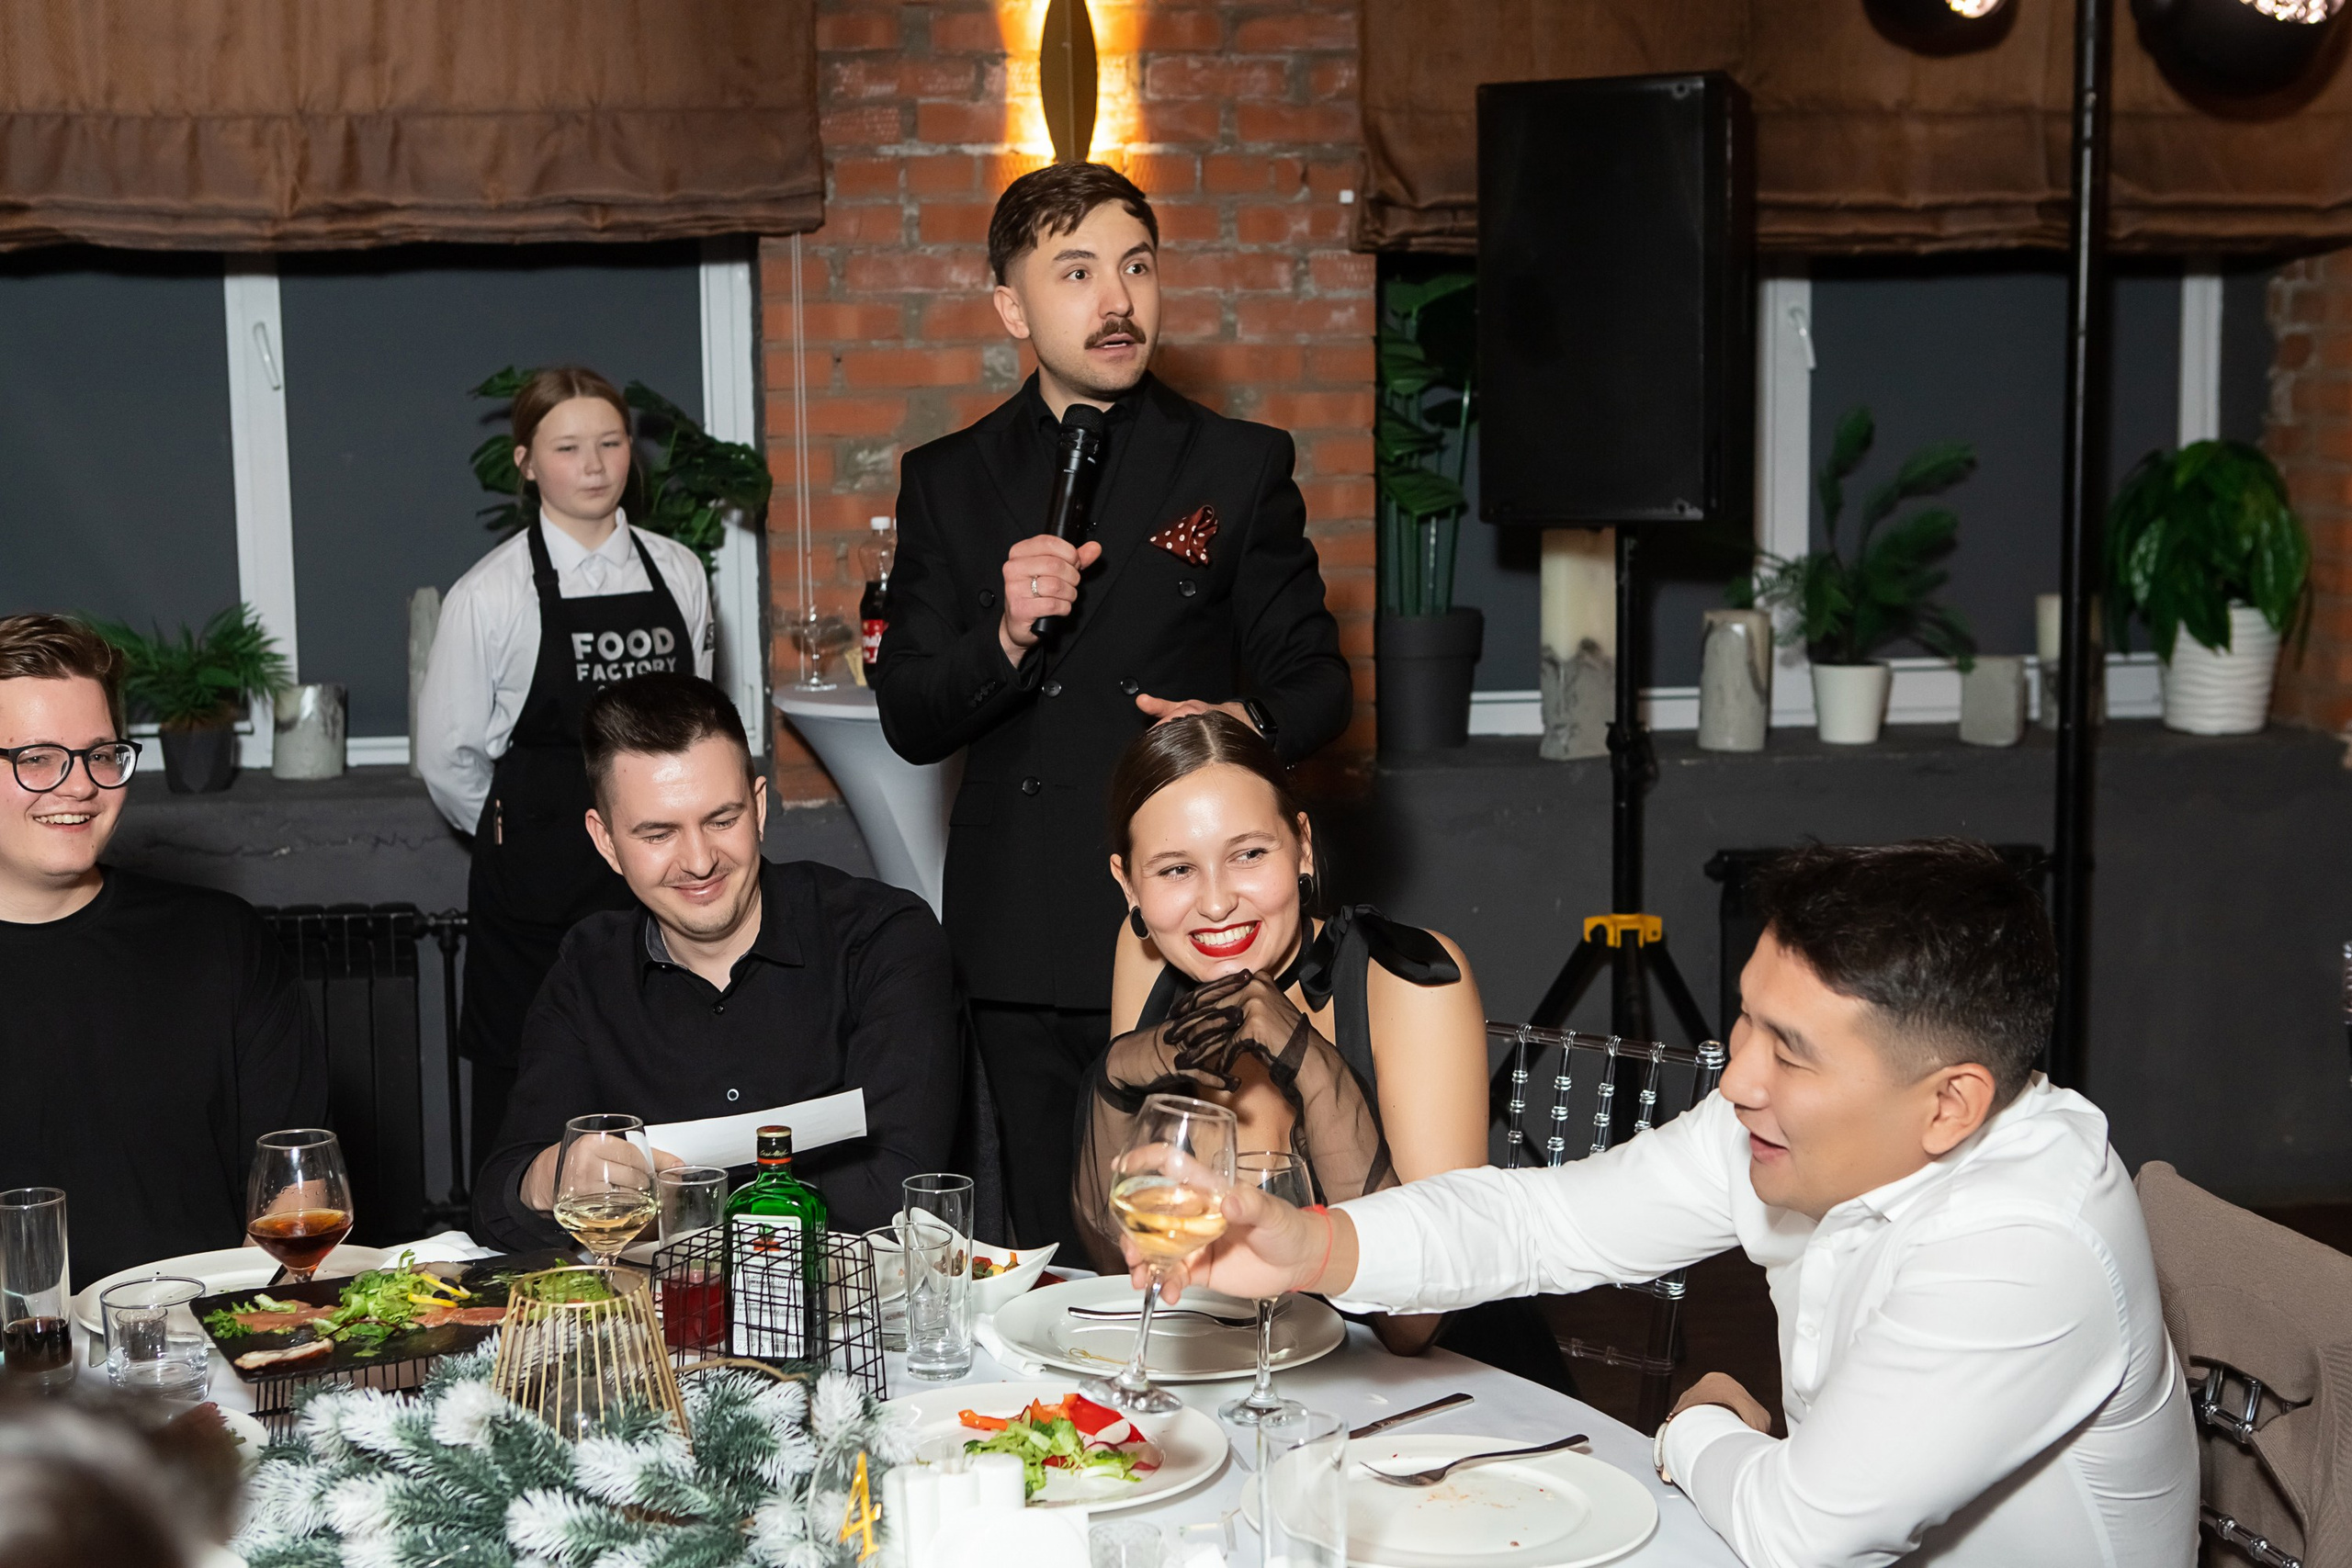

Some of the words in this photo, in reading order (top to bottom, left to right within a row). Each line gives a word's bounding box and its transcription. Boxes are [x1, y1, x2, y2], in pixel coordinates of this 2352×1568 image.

[571, 627, 675, 660] FOOD
[576, 657, 676, 682] FACTORY
[839, 1450, 882, 1563] 4
